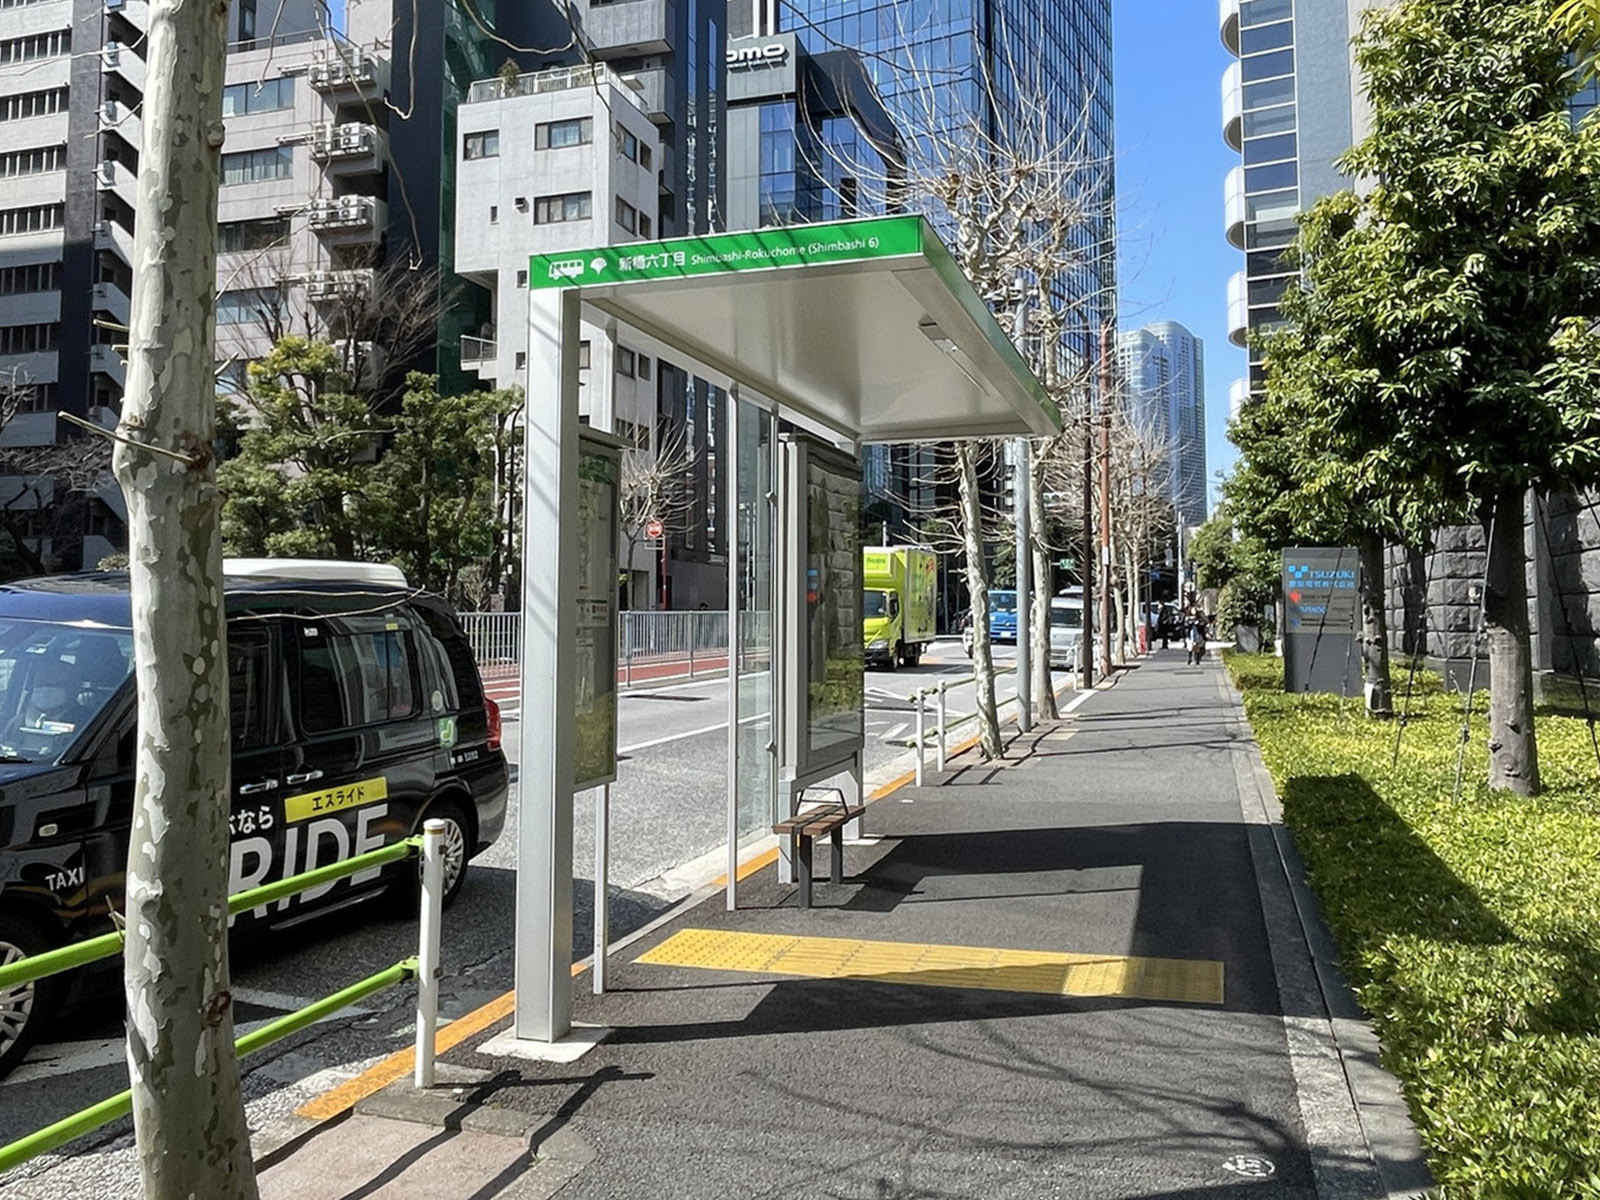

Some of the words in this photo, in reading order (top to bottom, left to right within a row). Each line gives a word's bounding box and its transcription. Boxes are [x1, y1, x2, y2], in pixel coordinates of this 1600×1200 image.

[618, 251, 686, 272] 新橋六丁目
[691, 246, 806, 266] Shimbashi-Rokuchome
[808, 239, 866, 256] (Shimbashi
[868, 236, 880, 249] 6)
[312, 786, 365, 812] エスライド
[45, 866, 85, 892] TAXI
